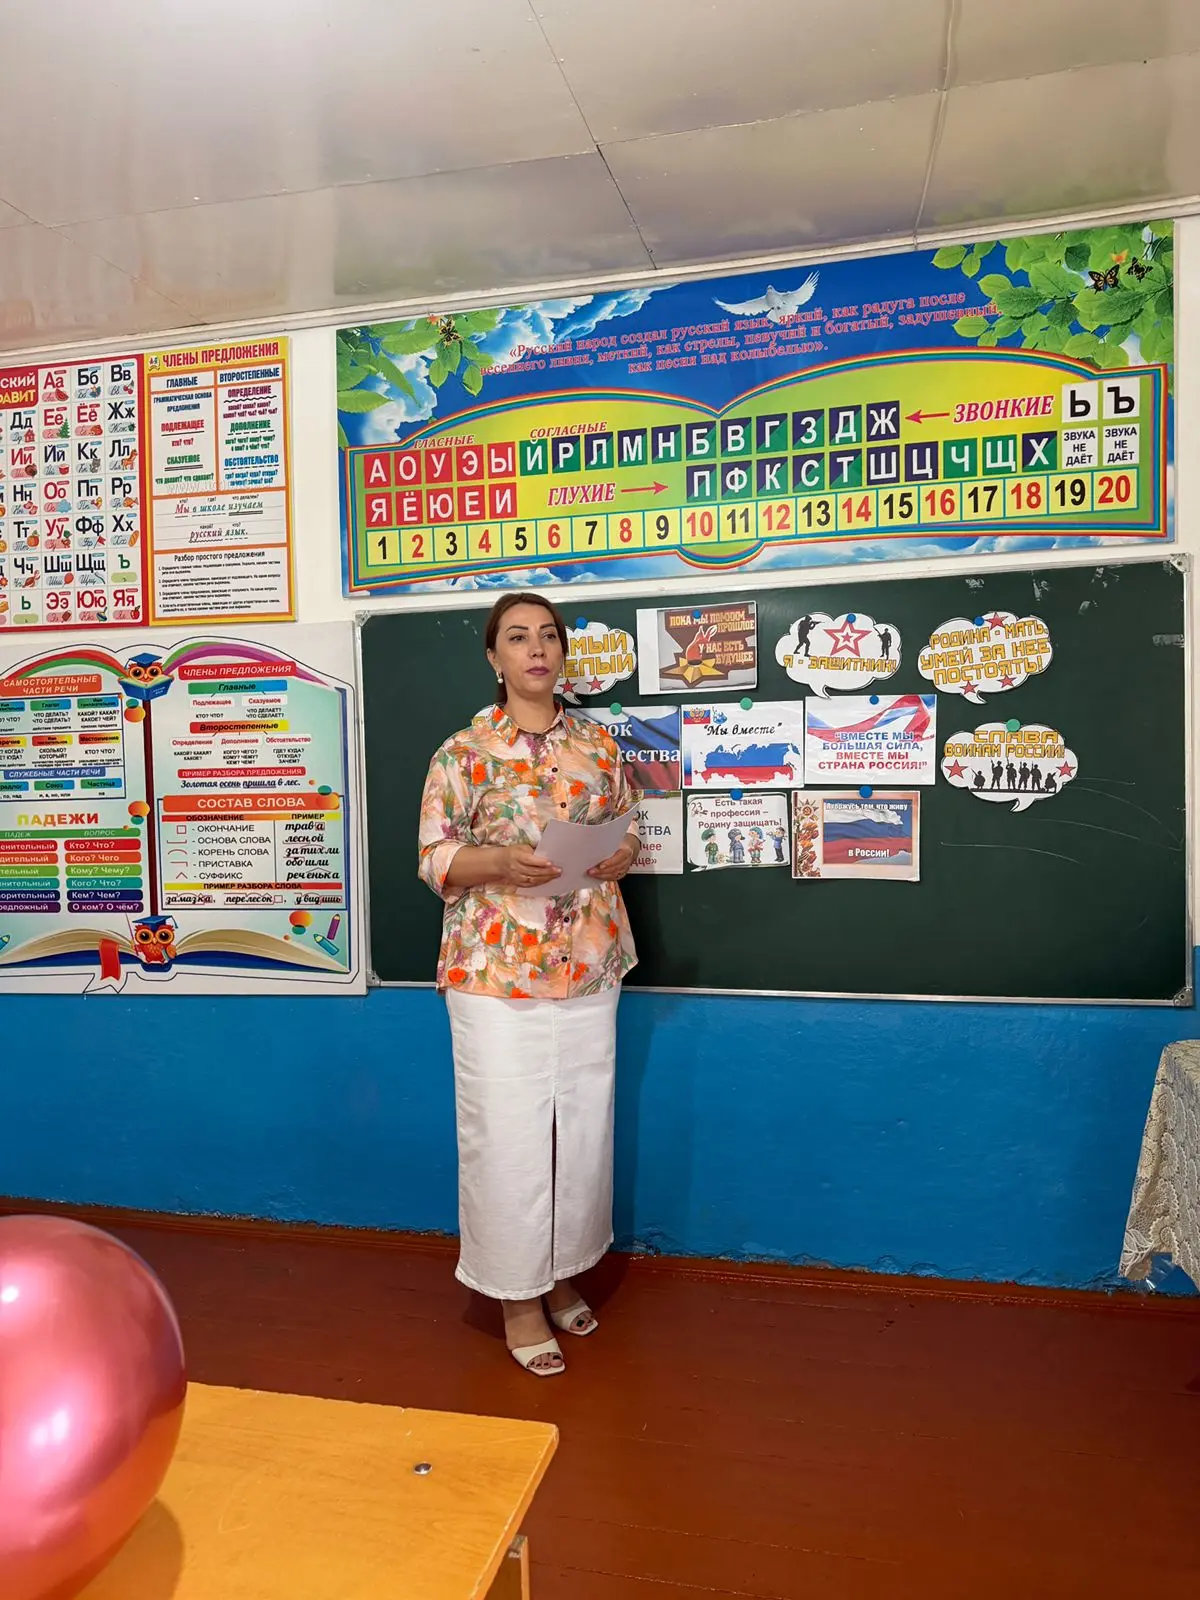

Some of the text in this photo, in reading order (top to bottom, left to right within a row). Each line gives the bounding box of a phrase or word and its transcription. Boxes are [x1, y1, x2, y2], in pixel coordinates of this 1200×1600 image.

[509, 290, 966, 360] «Русский народ создал русский язык, яркий, как радуга после
[480, 303, 1003, 377] весеннего ливня, меткий, как стрелы, певучий и богатый, задушевный,
[163, 342, 279, 368] ЧЛЕНЫ ПРЕДЛОЖЕНИЯ
[628, 341, 828, 375] как песня над колыбелью».
[43, 364, 132, 390] Аа Бб Вв
[219, 368, 280, 383] ВТОРОСТЕПЕННЫЕ
[166, 377, 198, 389] ГЛАВНЫЕ
[228, 385, 272, 398] ОПРЕДЕЛЕНИЕ
[1070, 386, 1135, 416] Ь Ъ
[953, 395, 1054, 424] ЗВОНКИЕ
[161, 419, 205, 432] ПОДЛЕЖАЩЕЕ
[529, 421, 607, 441] СОГЛАСНЫЕ
[1063, 429, 1096, 443] ЗВУКА
[1104, 426, 1138, 440] ЗВУКА
[413, 434, 474, 451] ГЛАСНЫЕ
[1072, 442, 1087, 454] НЕ
[1114, 440, 1128, 452] НЕ
[166, 454, 201, 466] СКАЗУЕМОЕ
[224, 454, 279, 467] ОБСТОЯТЕЛЬСТВО
[1065, 453, 1094, 468] ДАЁТ
[1106, 450, 1135, 465] ДАЁТ
[547, 482, 616, 508] ГЛУХИЕ
[175, 504, 190, 514] Мы
[199, 503, 226, 513] школе
[228, 501, 264, 513] изучаем
[377, 474, 1132, 559] 1 2 3 4 5 6 7 8 9 10 11 12 13 14 15 16 17 18 19 20
[190, 528, 248, 540] русский язык.
[174, 551, 266, 563] Разбор простого предложения
[669, 614, 692, 626] ПОКА
[567, 630, 628, 657] МЫЙ
[930, 627, 990, 650] РОДИНА
[705, 641, 722, 653] НАС
[723, 640, 744, 651] ЕСТЬ
[715, 651, 754, 665] БУДУЩЕЕ
[920, 638, 1051, 675] УМЕЙ ЗА НЕЕ
[183, 664, 293, 677] ЧЛЕНЫ ПРЕДЛОЖЕНИЯ
[557, 651, 634, 680] ЕЛЫЙ
[783, 654, 897, 674] Я ЗАЩИТНИК!
[933, 655, 1043, 686] ПОСТОЯТЬ!
[3, 675, 98, 688] САМОСТОЯТЕЛЬНЫЕ
[218, 683, 257, 692] Главные
[23, 685, 79, 695] ЧАСТИ РЕЧИ
[199, 722, 279, 732] Второстепенные
[973, 729, 1060, 745] СЛАВА
[822, 742, 924, 751] БОЛЬШАЯ СИЛА,
[943, 742, 1066, 760] ВОИНАМ РОССИИ!
[836, 751, 909, 760] ВМЕСТЕ МЫ
[818, 761, 866, 770] СТРАНА
[8, 771, 55, 779] СЛУЖЕБНЫЕ
[56, 769, 80, 777] ЧАСТИ
[180, 780, 219, 789] Золотая
[219, 780, 242, 788] осень
[242, 779, 277, 788] пришла
[284, 779, 301, 787] лес.
[197, 796, 307, 809] СОСТАВ СЛОВА
[714, 799, 736, 807] Есть
[17, 813, 100, 827] ПАДЕЖИ
[710, 809, 761, 819] профессия
[197, 824, 256, 833] ОКОНЧАНИЕ
[285, 821, 325, 832] трава
[698, 818, 783, 830] Родину защищать!
[69, 840, 116, 849] Кто? Что?
[197, 836, 272, 845] ОСНОВА СЛОВА
[285, 833, 325, 843] лесной
[70, 853, 120, 862] Кого? Чего
[197, 848, 270, 856] КОРЕНЬ СЛОВА
[848, 848, 890, 858] в России!
[198, 860, 254, 868] ПРИСТАВКА
[198, 872, 244, 880] СУФФИКС
[71, 890, 121, 899] Кем? Чем?
